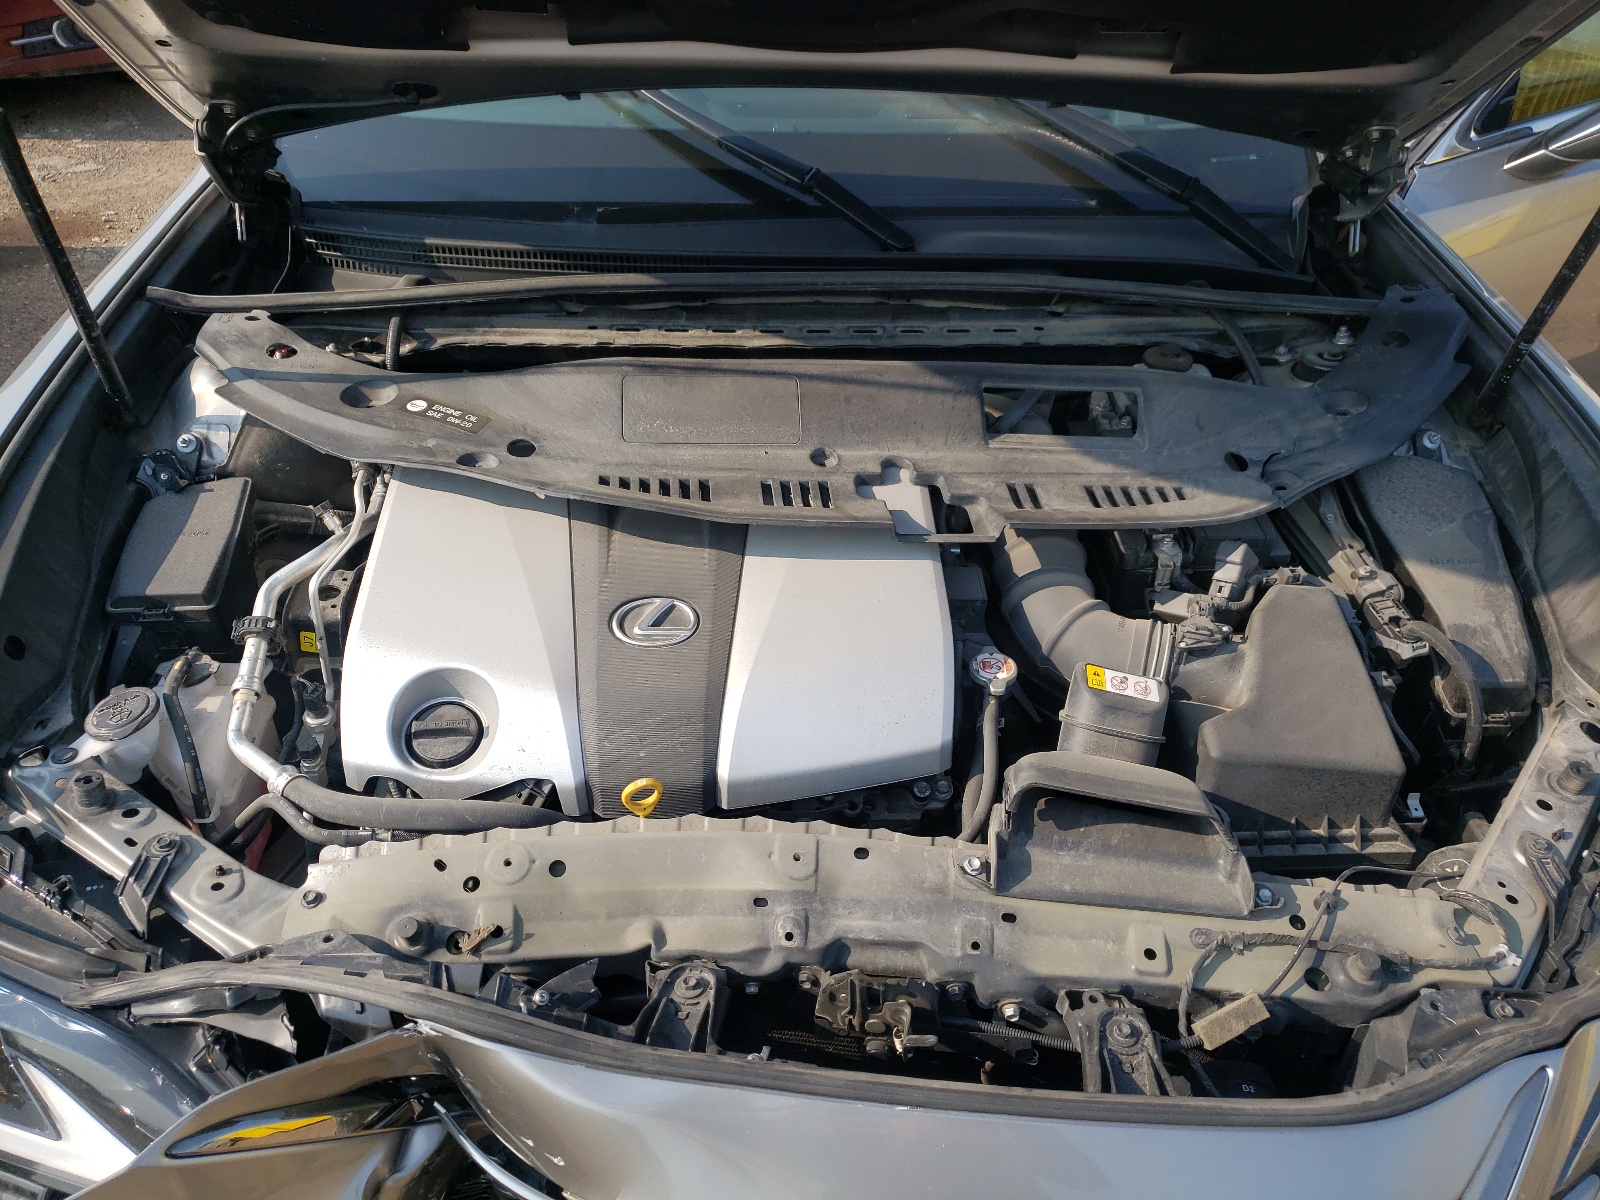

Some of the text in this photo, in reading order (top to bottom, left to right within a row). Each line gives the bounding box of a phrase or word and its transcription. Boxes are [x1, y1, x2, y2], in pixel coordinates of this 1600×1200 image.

[426, 410, 473, 428] SAE 0W-20
[432, 404, 462, 417] ENGINE
[465, 414, 478, 423] OIL
[1241, 1084, 1256, 1093] D2
